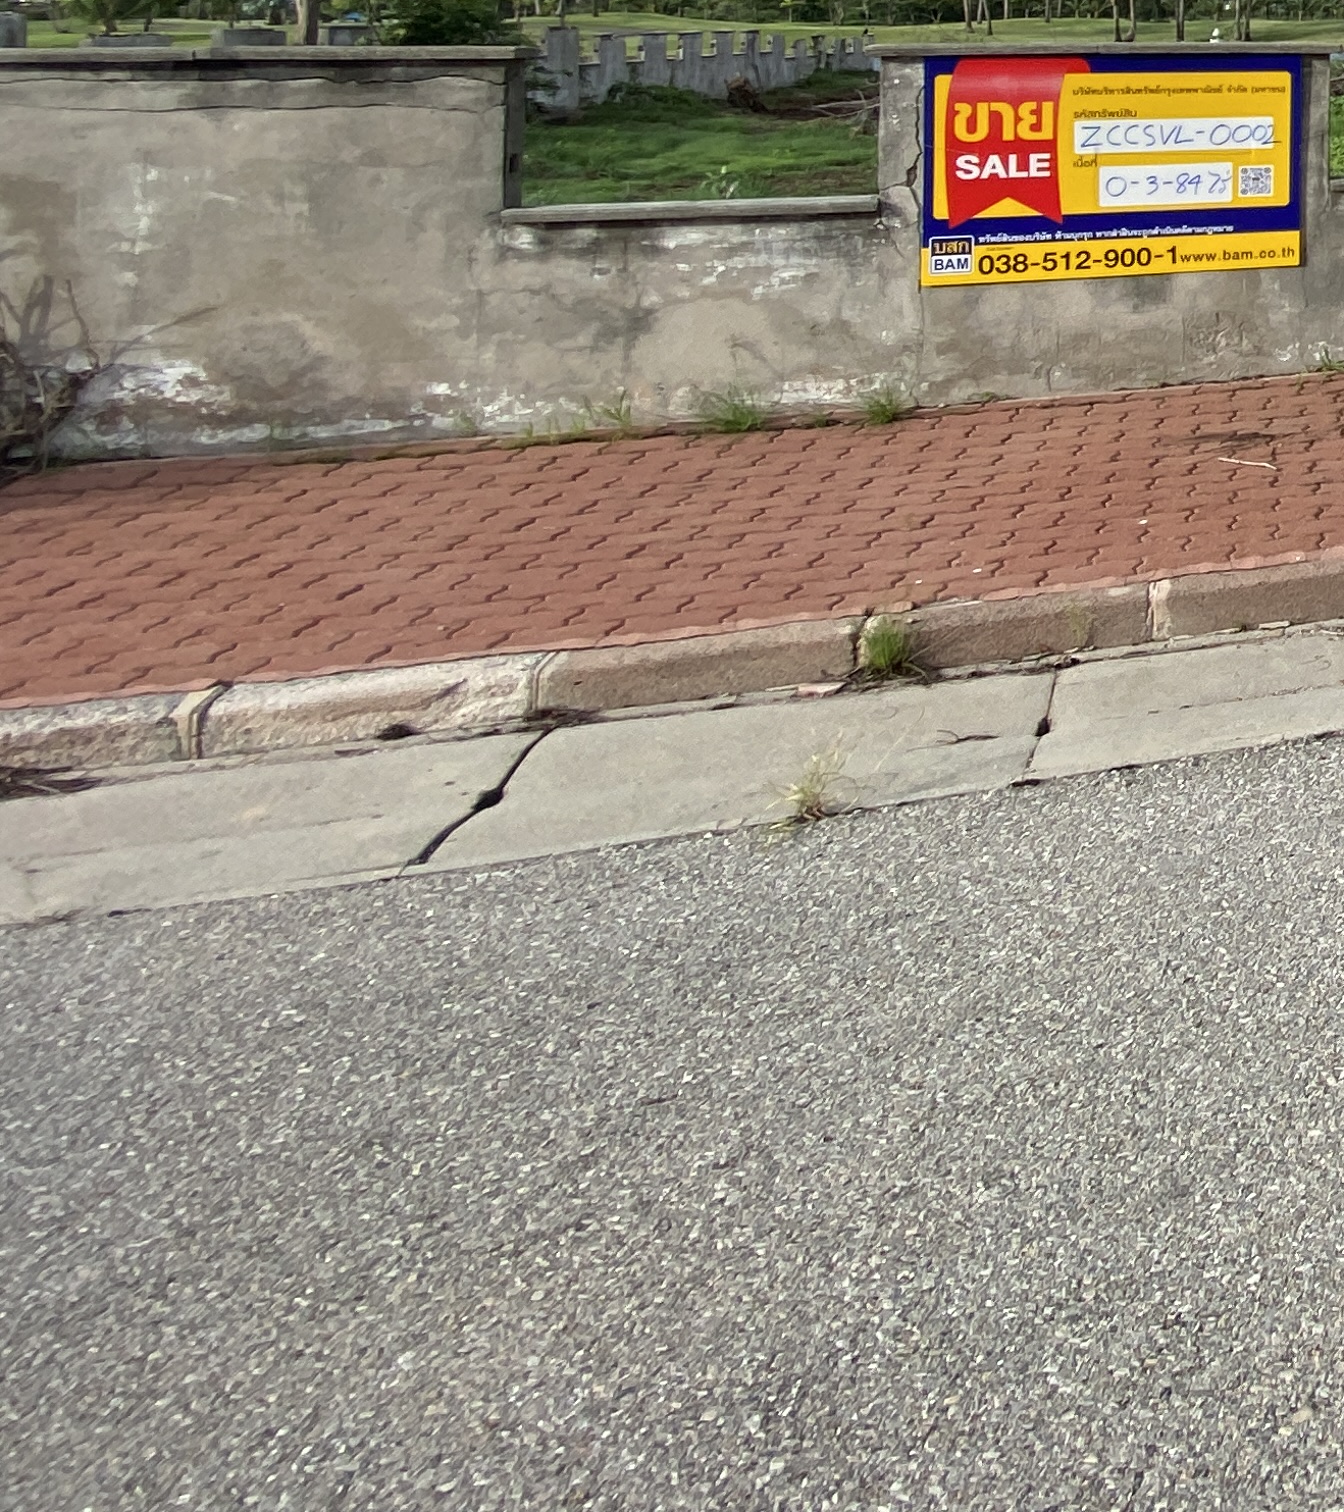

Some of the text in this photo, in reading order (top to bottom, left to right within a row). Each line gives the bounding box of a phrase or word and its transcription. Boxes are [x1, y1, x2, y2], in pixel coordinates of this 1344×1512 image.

[954, 101, 1055, 143] ขาย
[1080, 123, 1282, 148] ZCCSVL-0002
[955, 153, 1051, 180] SALE
[933, 240, 970, 254] บสก
[978, 245, 1295, 275] 038-512-900-1 www.bam.co.th
[934, 257, 969, 271] BAM
